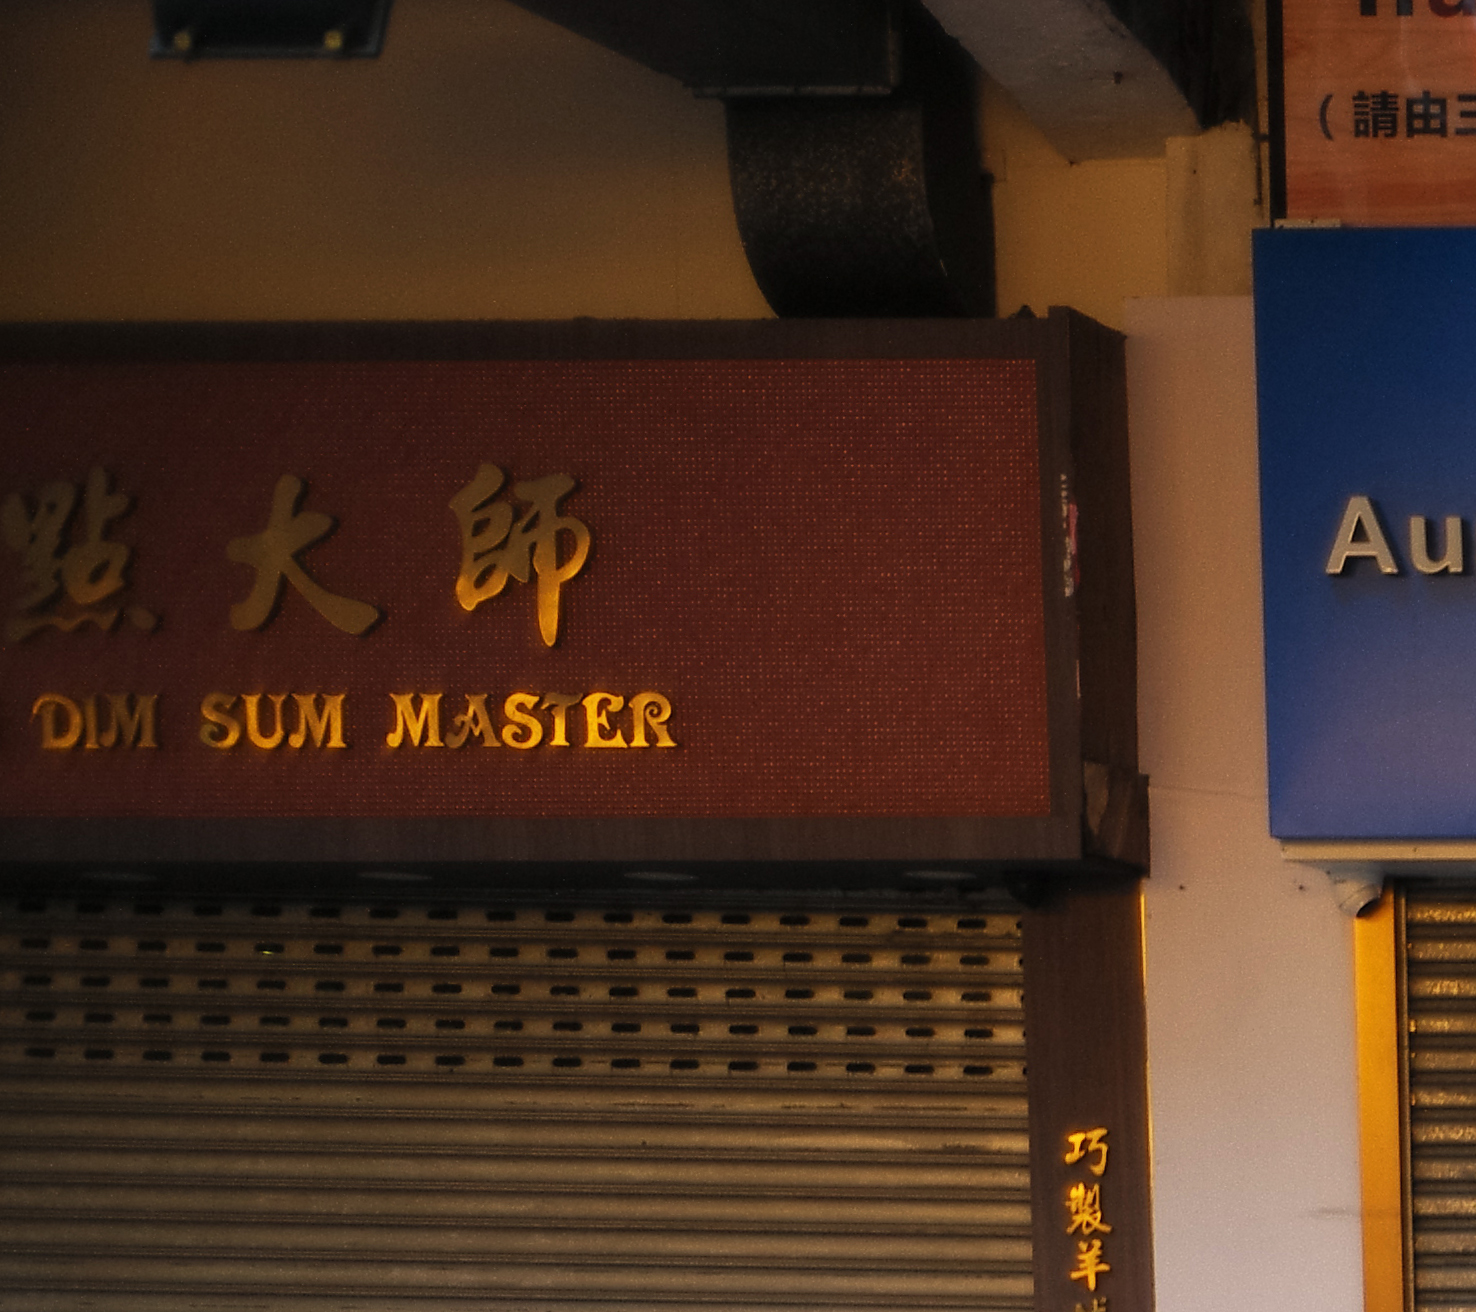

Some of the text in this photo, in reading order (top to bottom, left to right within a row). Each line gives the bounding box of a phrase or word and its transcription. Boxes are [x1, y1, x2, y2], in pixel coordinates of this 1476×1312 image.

[4, 463, 593, 649] 點大師
[33, 691, 678, 752] DIM SUM MASTER
